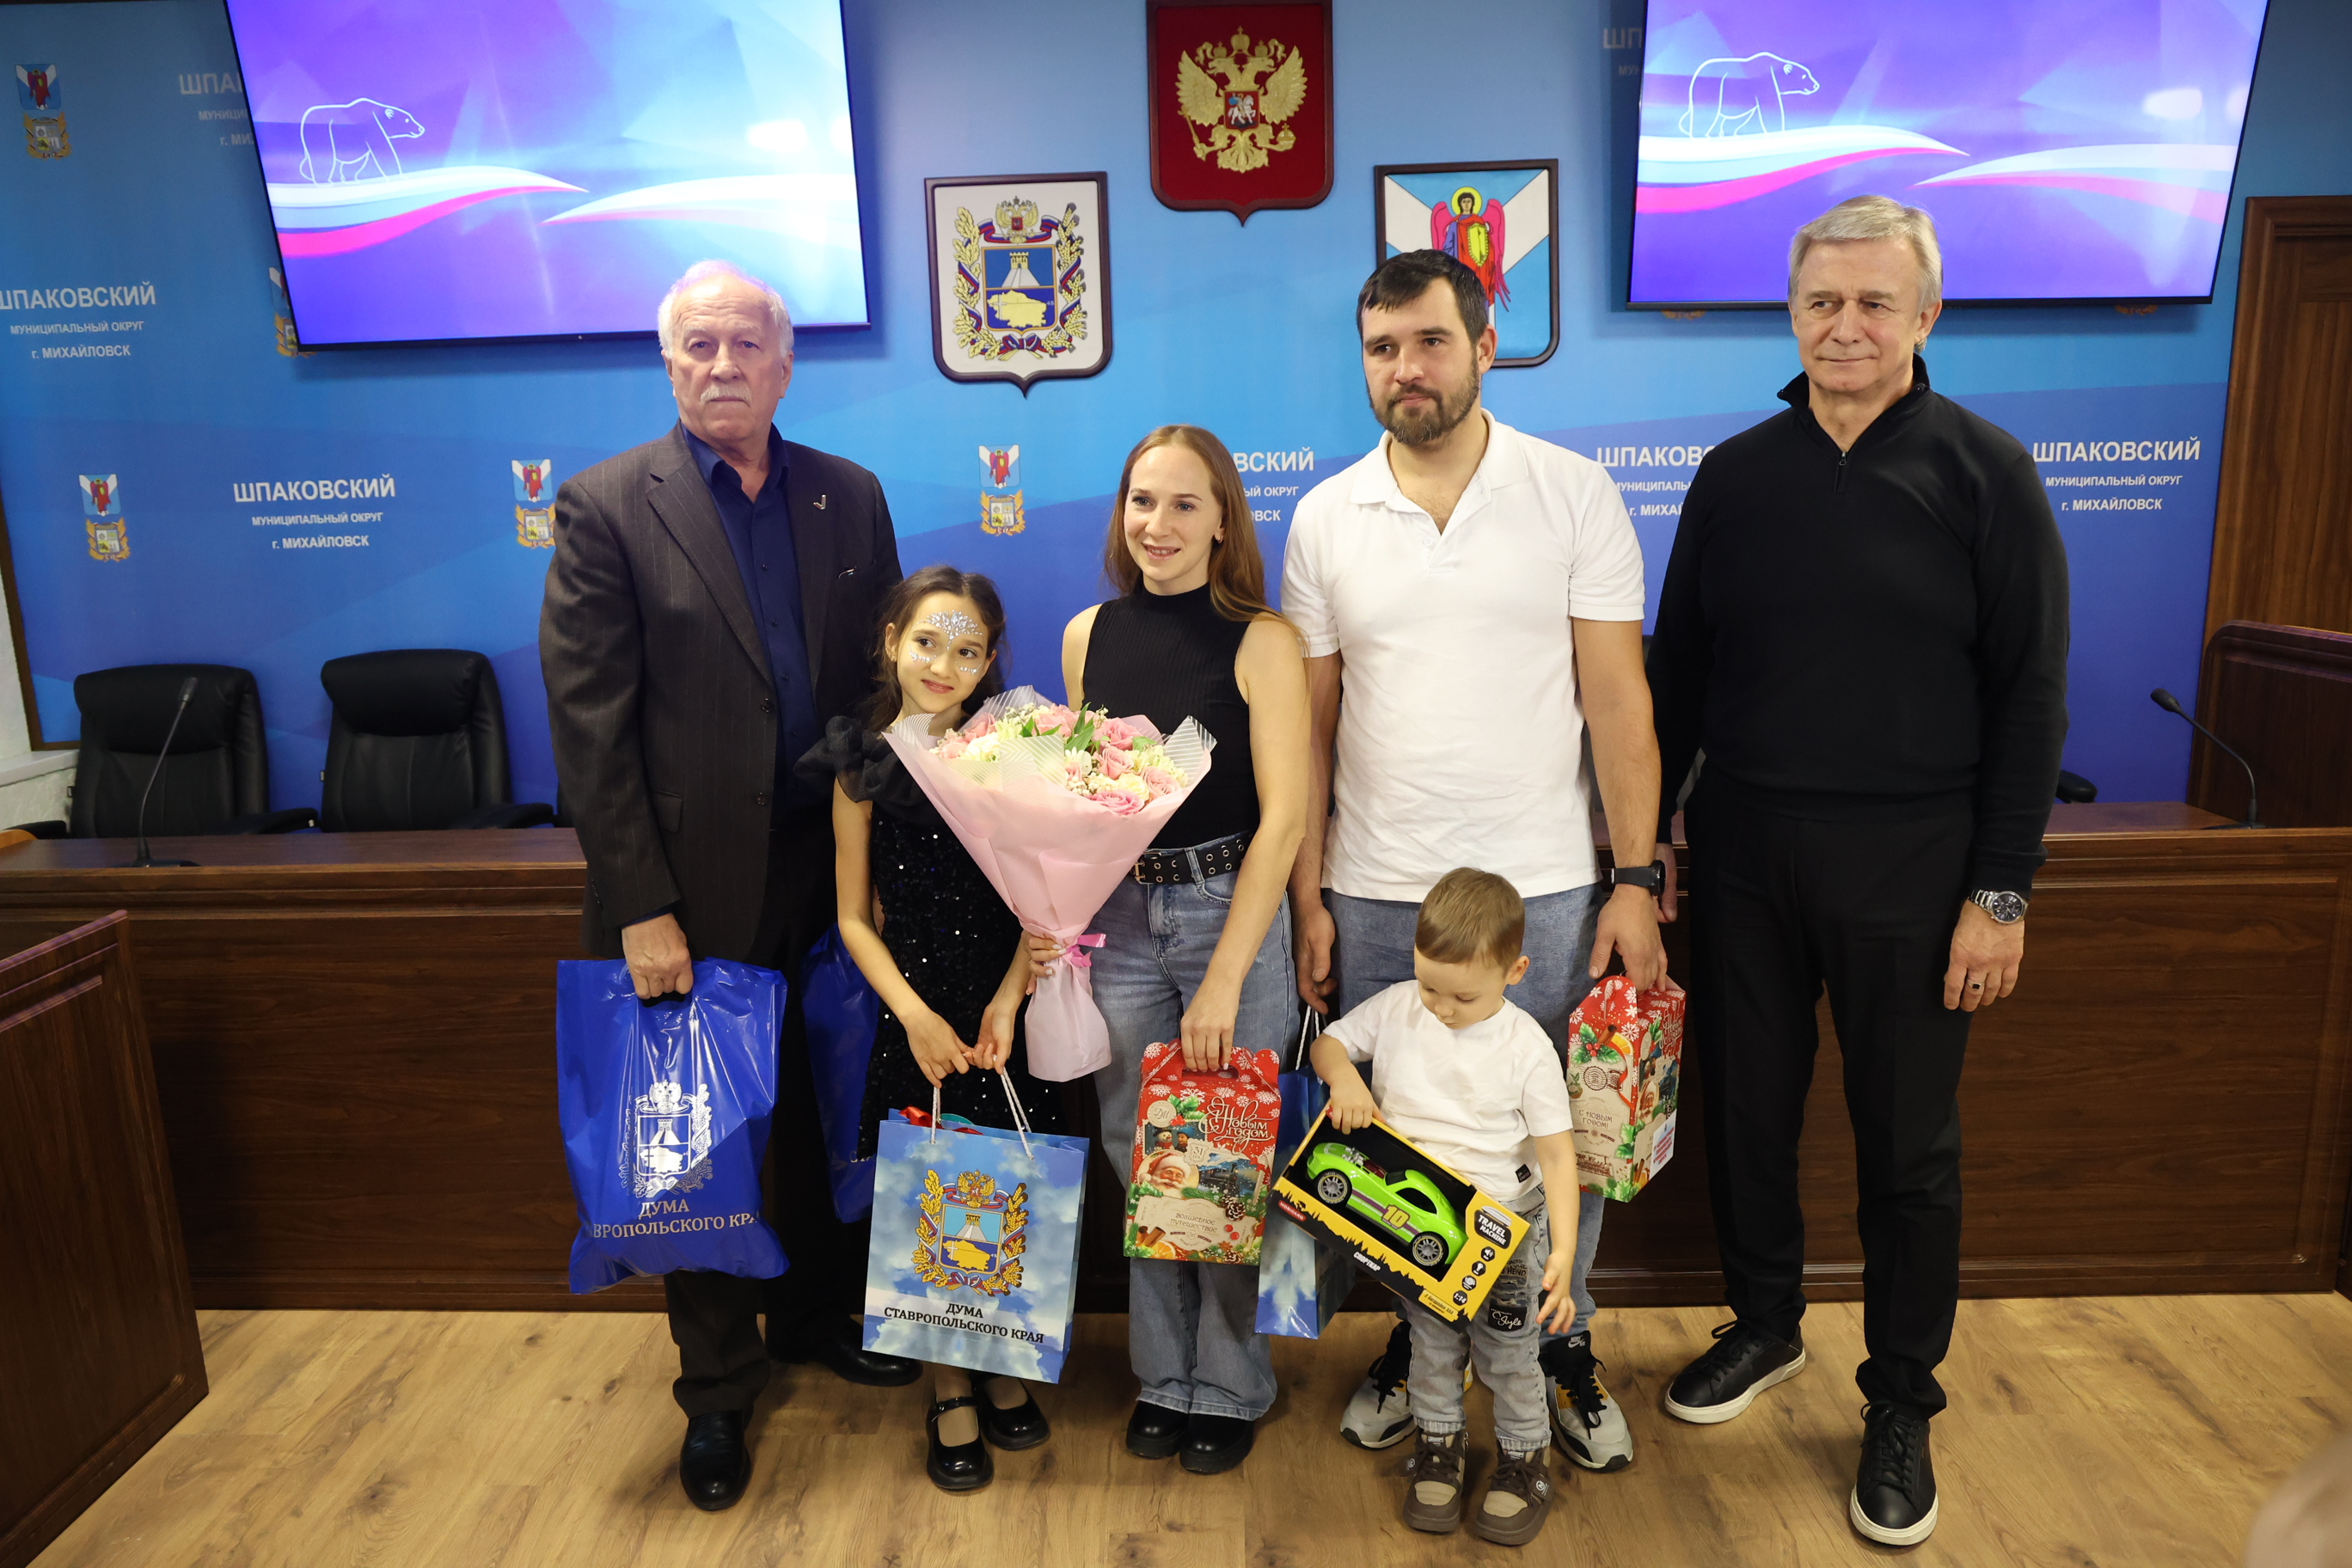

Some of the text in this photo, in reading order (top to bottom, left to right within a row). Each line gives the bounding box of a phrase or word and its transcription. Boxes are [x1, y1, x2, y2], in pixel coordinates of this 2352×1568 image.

[10, 321, 144, 335] МУНИЦИПАЛЬНЫЙ ОКРУГ
[31, 345, 131, 358] г. МИХАЙЛОВСК
[2032, 436, 2201, 462] ШПАКОВСКИЙ
[233, 473, 395, 502] ШПАКОВСКИЙ
[2045, 475, 2183, 487] МУНИЦИПАЛЬНЫЙ ОКРУГ
[1264, 487, 1299, 496] ОКРУГ
[1629, 507, 1637, 516] г.
[2061, 497, 2163, 511] г. МИХАЙЛОВСК
[252, 511, 383, 526] МУНИЦИПАЛЬНЫЙ ОКРУГ
[272, 535, 370, 549] г. МИХАЙЛОВСК
[639, 1198, 689, 1220] ДУМА
[1382, 1204, 1409, 1228] 10
[1478, 1214, 1506, 1238] TRAVEL
[1479, 1225, 1507, 1246] MACHINE
[1353, 1252, 1381, 1271] СПОРТКАР
[1453, 1293, 1467, 1304] 1:14
[946, 1303, 983, 1319] ДУМА
[884, 1307, 1044, 1344] СТАВРОПОЛЬСКОГО КРАЯ
